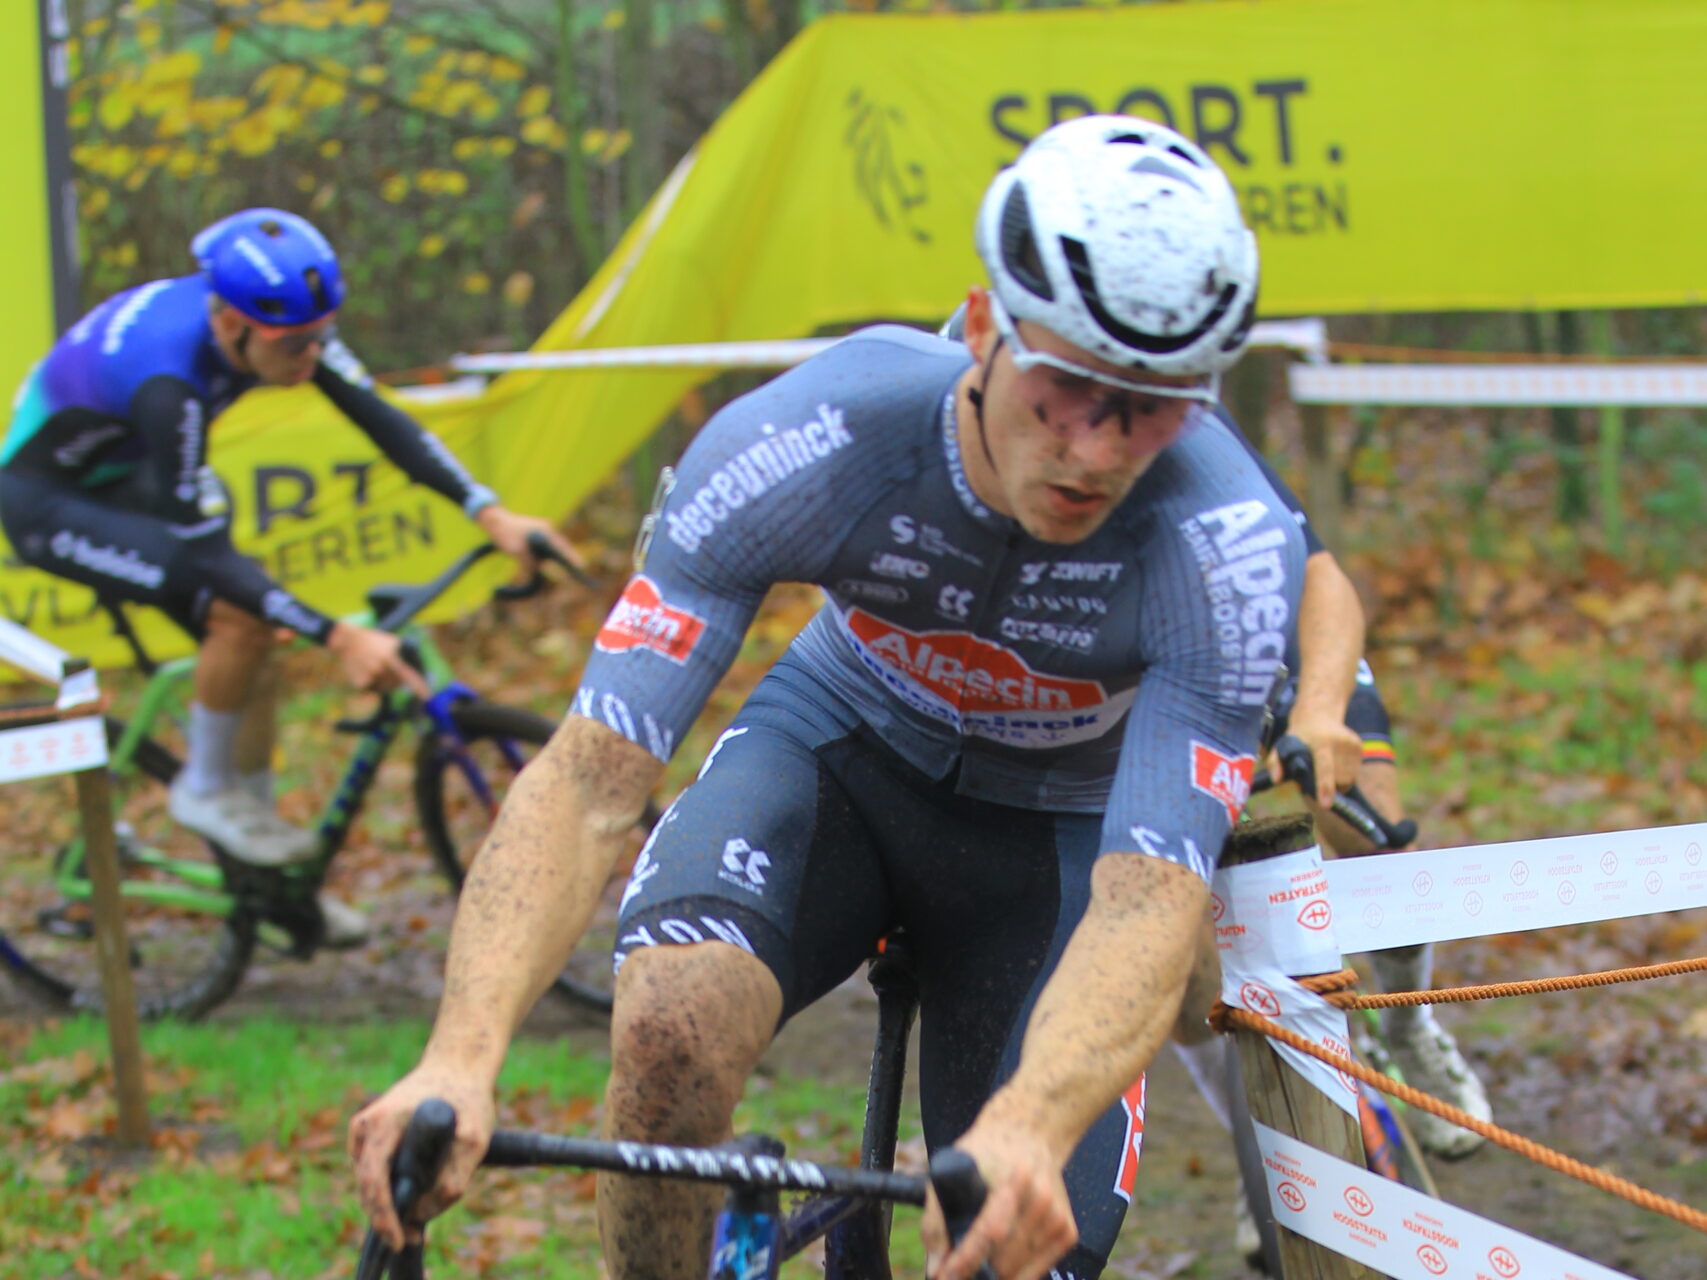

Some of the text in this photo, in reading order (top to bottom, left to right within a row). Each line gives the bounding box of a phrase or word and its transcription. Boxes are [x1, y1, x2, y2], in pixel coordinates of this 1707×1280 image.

[667, 403, 854, 553] deceuninck
[867, 631, 1072, 709] Alpecin
[1196, 499, 1289, 706] Alpecin
